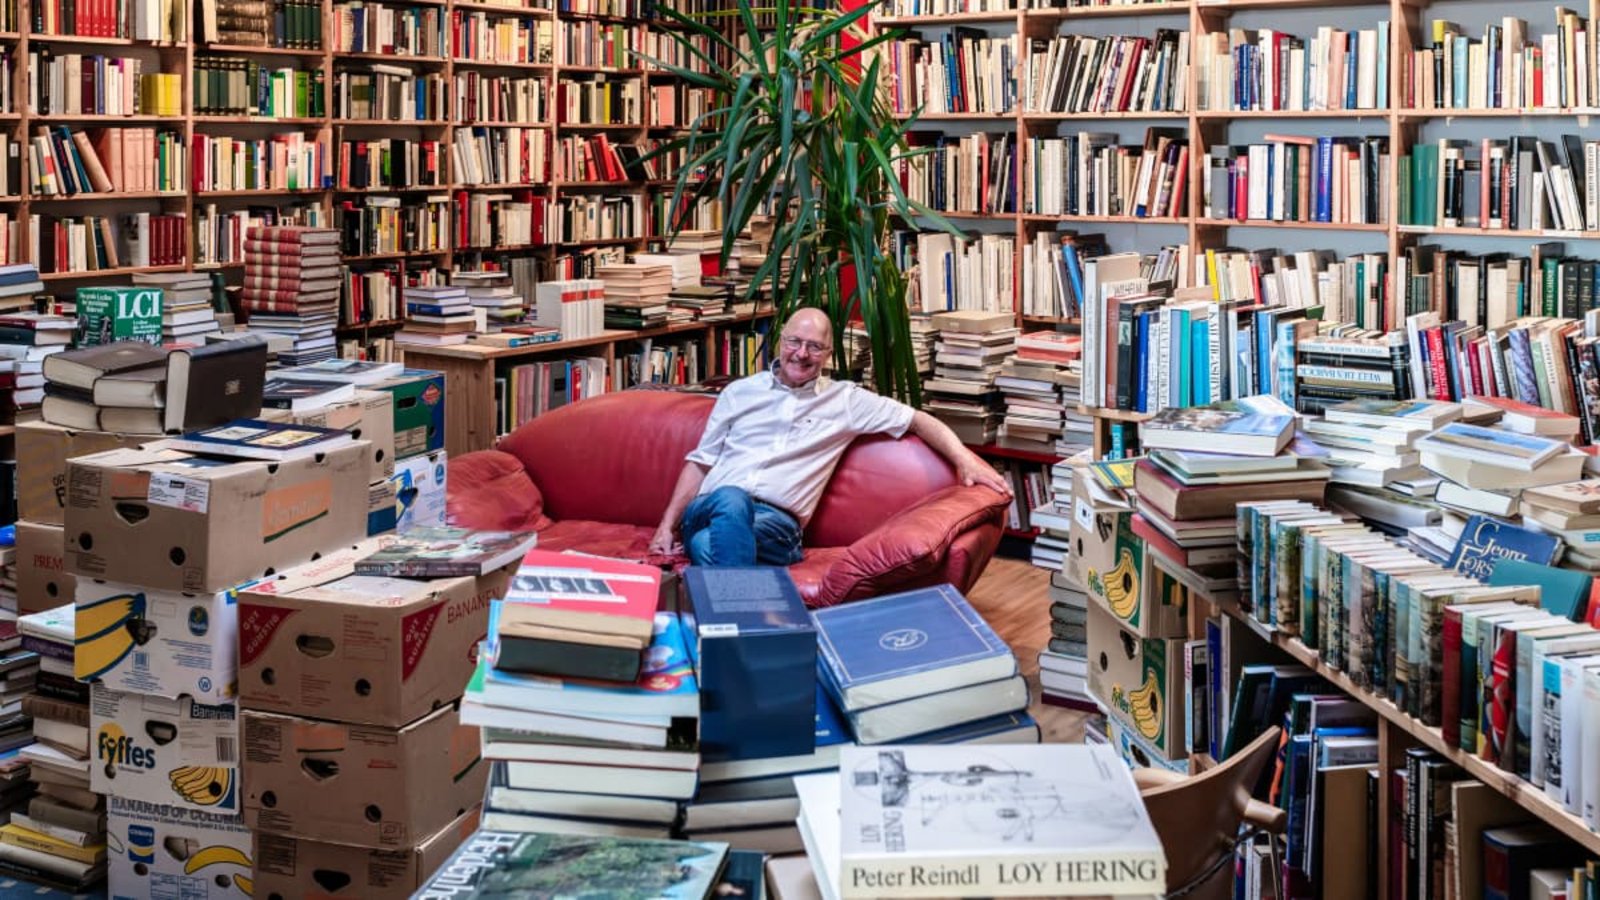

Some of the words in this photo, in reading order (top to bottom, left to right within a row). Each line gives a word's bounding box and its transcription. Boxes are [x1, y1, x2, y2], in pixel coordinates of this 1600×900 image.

[117, 291, 160, 319] LCI
[852, 864, 905, 888] Peter
[911, 864, 980, 886] Reindl
[998, 862, 1049, 884] LOY
[1056, 859, 1158, 883] HERING
